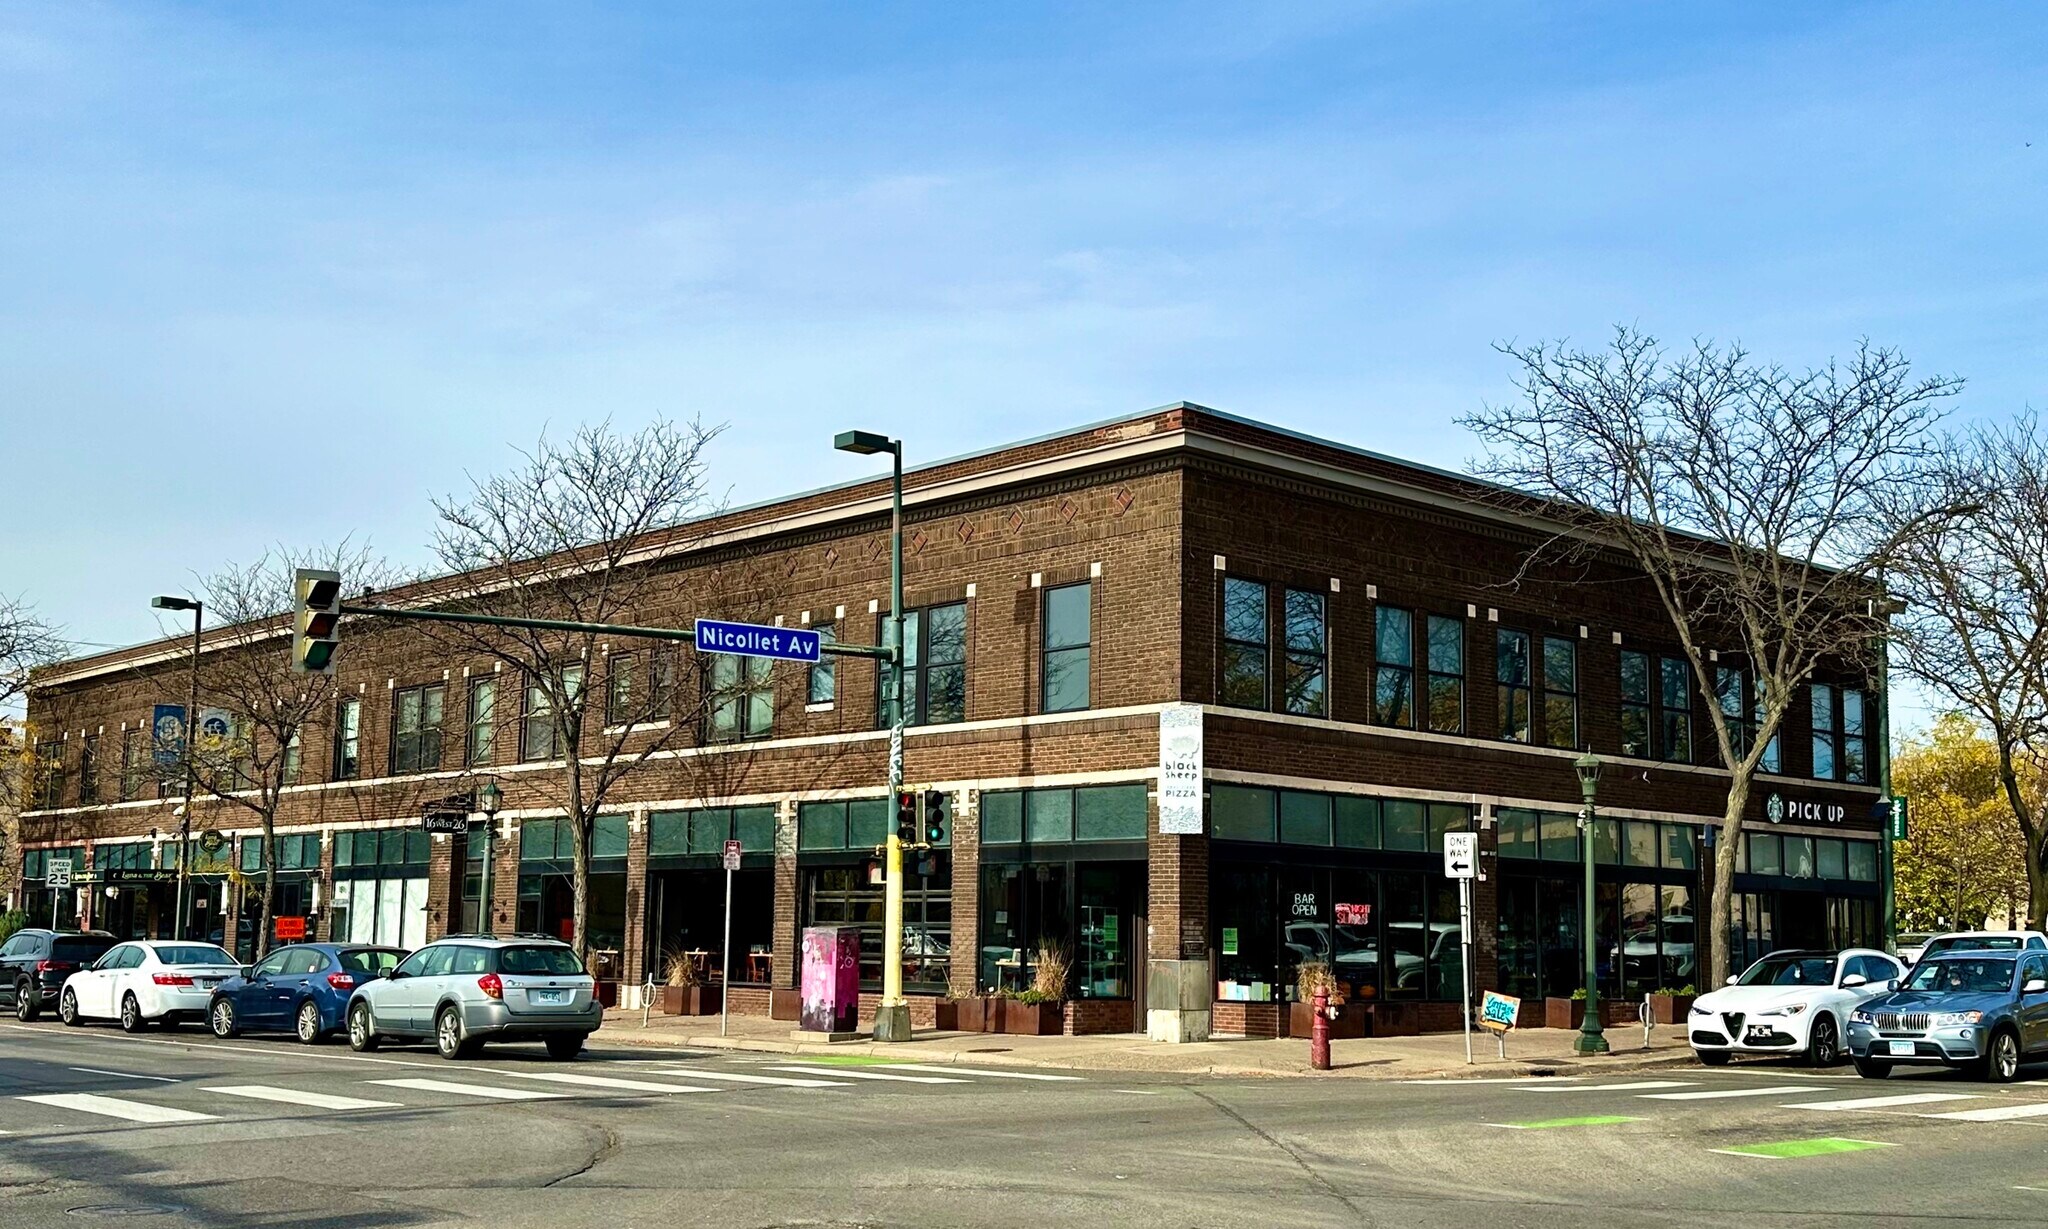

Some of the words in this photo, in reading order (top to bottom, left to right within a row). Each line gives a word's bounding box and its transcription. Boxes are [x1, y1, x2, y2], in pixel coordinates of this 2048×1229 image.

[703, 627, 780, 651] Nicollet
[788, 636, 813, 655] Av
[1165, 760, 1197, 770] black
[1788, 801, 1822, 820] PICK
[1827, 804, 1845, 822] UP
[426, 818, 436, 828] 16
[452, 818, 465, 830] 26
[1450, 836, 1467, 847] ONE
[1450, 849, 1468, 858] WAY
[48, 873, 69, 885] 25
[1294, 893, 1315, 904] BAR
[1291, 904, 1317, 916] OPEN
[1484, 1006, 1505, 1021] Sale
